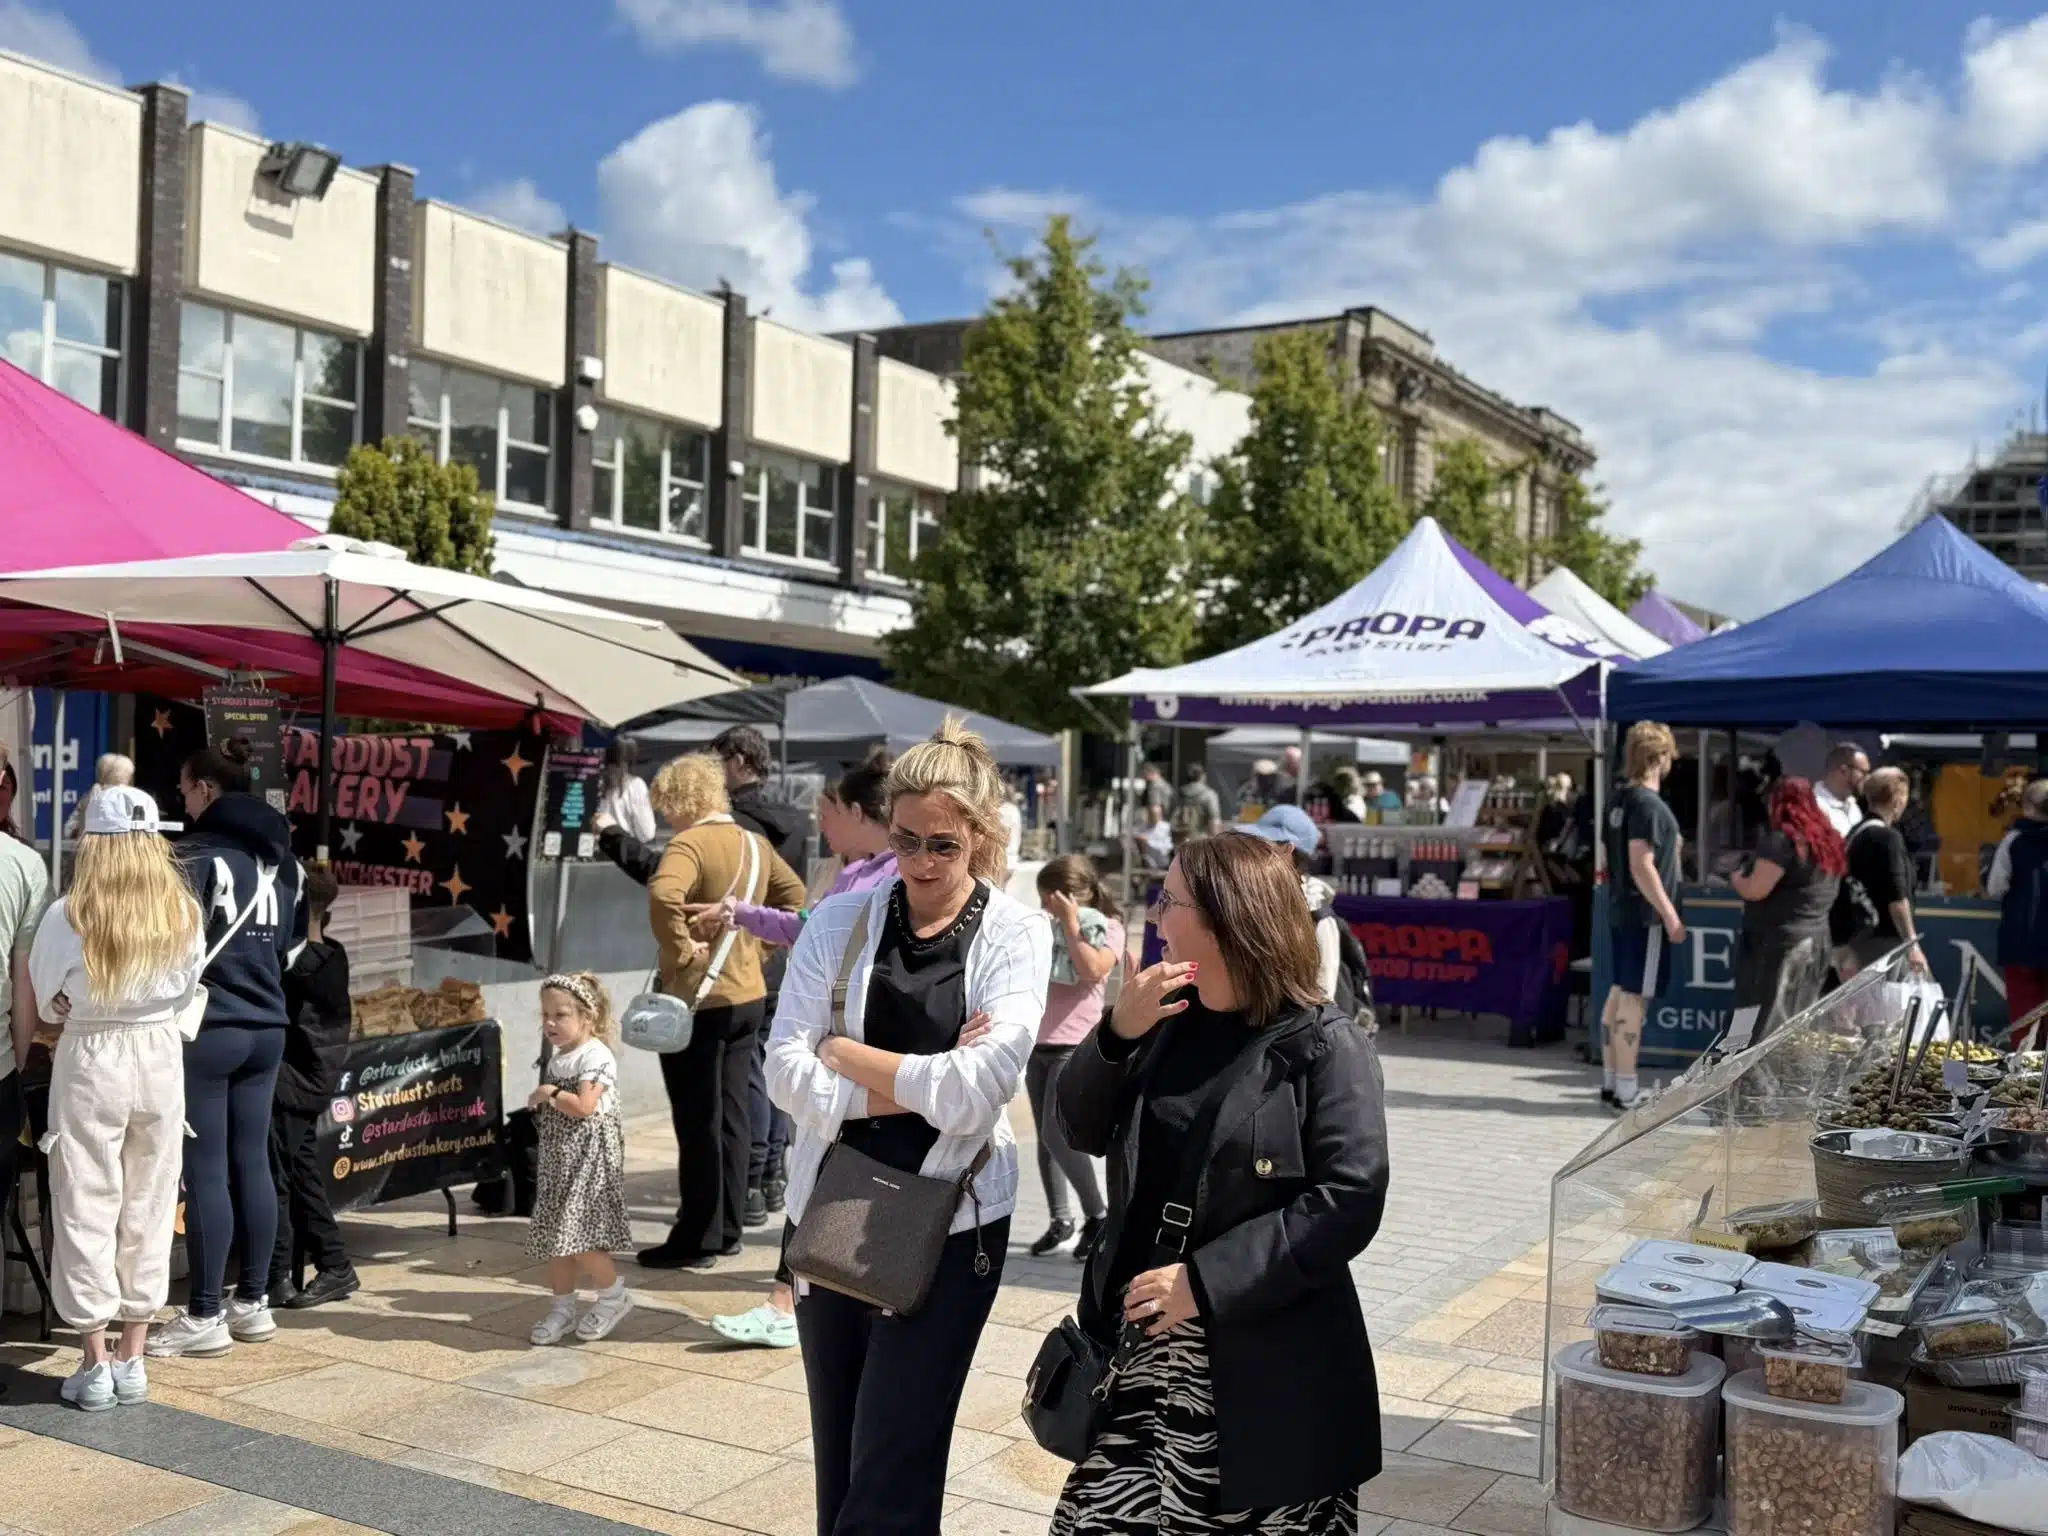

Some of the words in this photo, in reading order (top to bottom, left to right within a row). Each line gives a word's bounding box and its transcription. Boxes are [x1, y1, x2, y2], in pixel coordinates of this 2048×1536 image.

[1300, 612, 1486, 648] PROPA
[357, 1082, 424, 1112] Stardust
[352, 1129, 496, 1172] www.stardustbakery.co.uk
